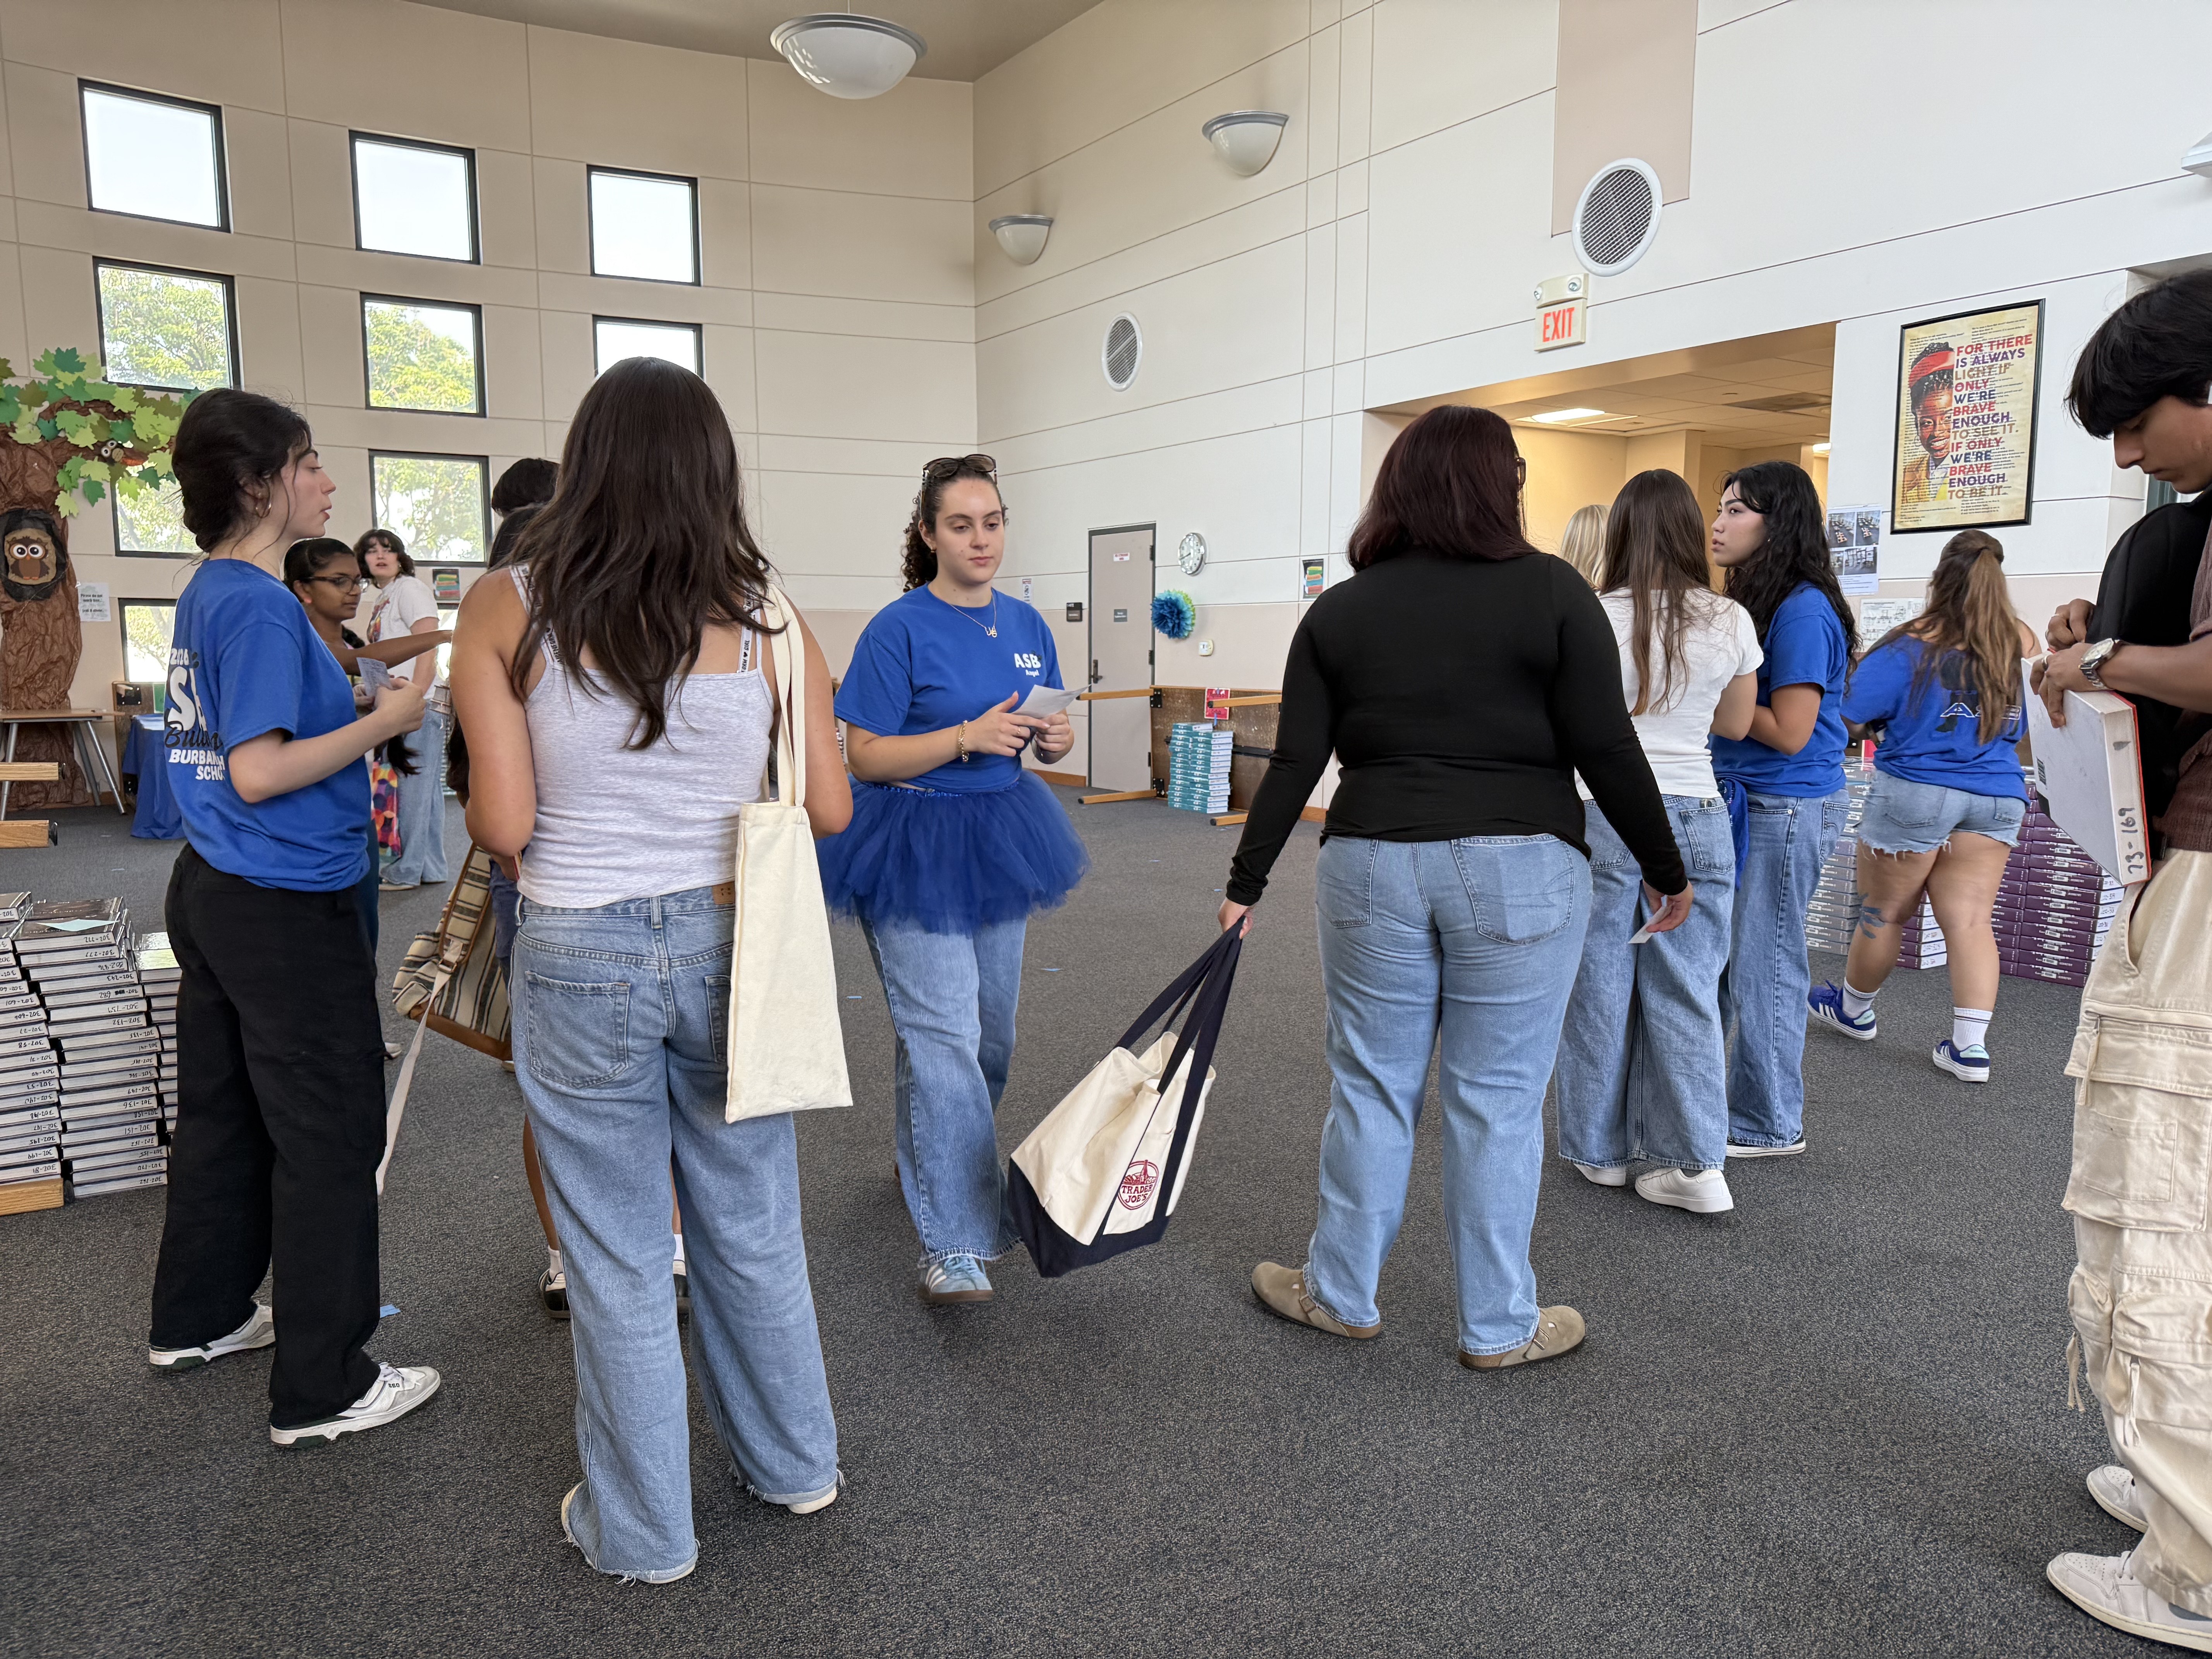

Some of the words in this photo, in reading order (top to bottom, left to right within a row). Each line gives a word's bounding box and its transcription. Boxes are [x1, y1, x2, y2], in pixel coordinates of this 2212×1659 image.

[1543, 307, 1575, 342] EXIT
[1957, 343, 1983, 356] FOR
[1988, 334, 2032, 350] THERE
[1956, 358, 1967, 368] IS
[1972, 348, 2025, 366] ALWAYS
[1955, 365, 1994, 380] LIGHT
[1999, 362, 2011, 374] IF
[1955, 378, 1989, 392] ONLY
[1954, 390, 1996, 404] WE'RE
[1953, 401, 1996, 416] BRAVE
[1953, 413, 2009, 429] ENOUGH
[1952, 429, 1968, 440] TO
[1974, 426, 1998, 436] SEE
[2003, 423, 2018, 434] IT.
[1951, 442, 1963, 452] IF
[1967, 437, 2002, 450] ONLY
[1951, 450, 1992, 464] WE'RE
[1949, 463, 1992, 476] BRAVE
[1949, 473, 2005, 488] ENOUGH
[1948, 489, 1965, 499] TO
[1970, 487, 1986, 497] BE
[1014, 653, 1041, 668] ASB
[2118, 807, 2144, 874] 73-169
[6, 998, 34, 1006] 302-601
[108, 1003, 139, 1013] 302-739
[29, 1136, 55, 1145] 302-195
[1121, 1184, 1153, 1194] TRADER
[1125, 1194, 1148, 1203] JOE'S
